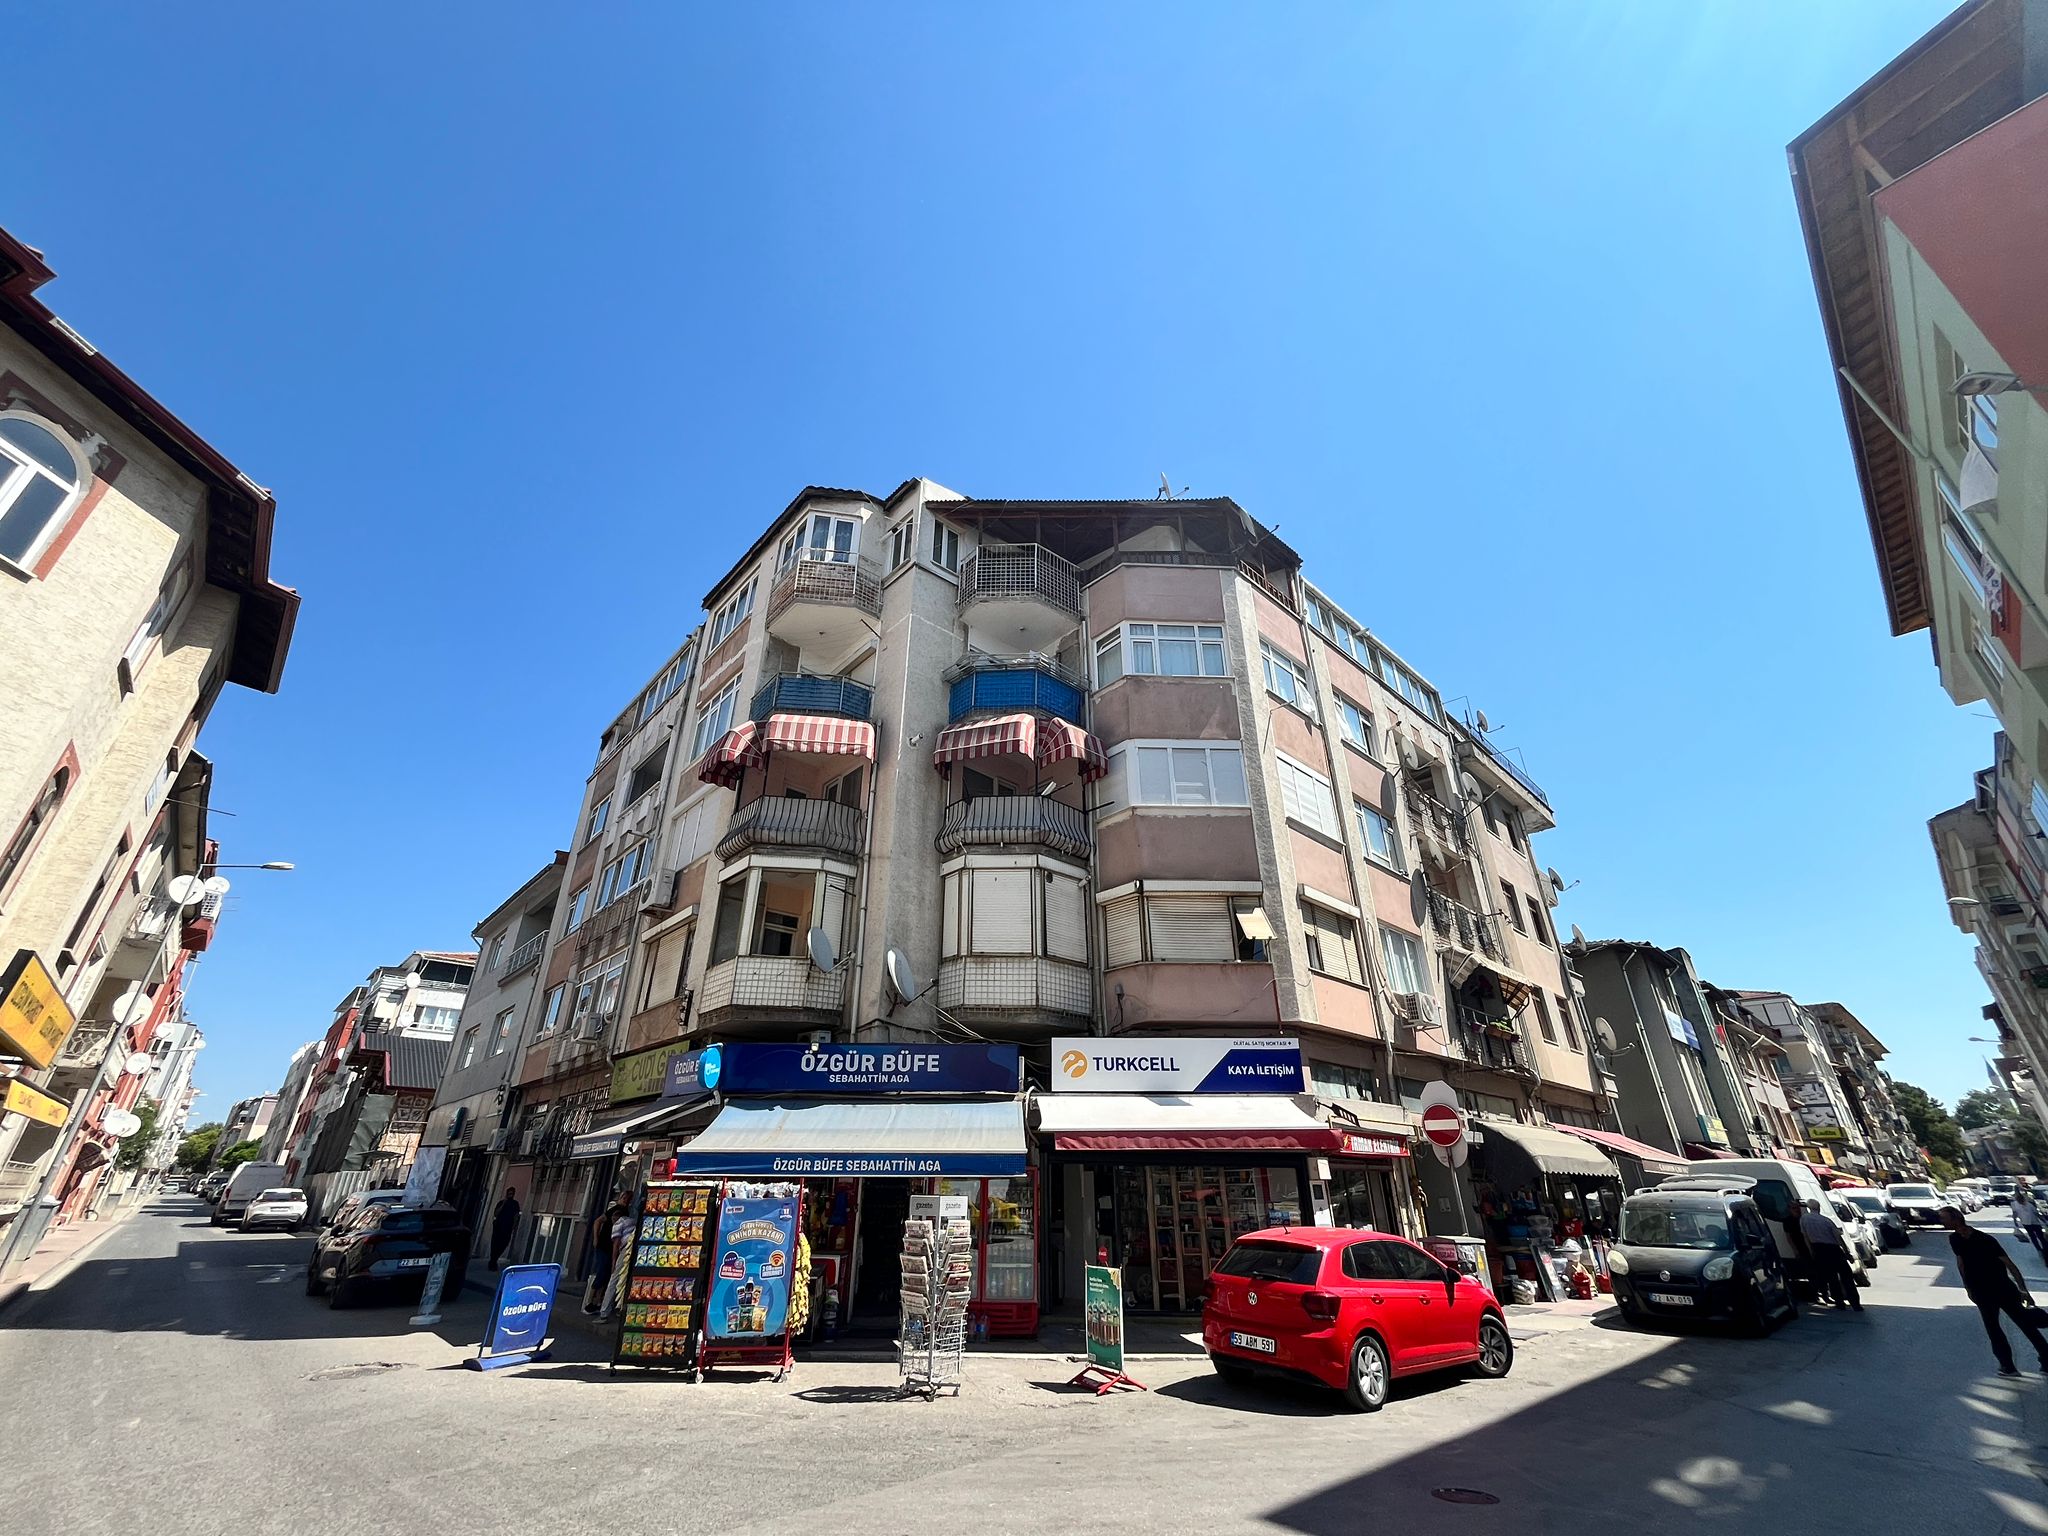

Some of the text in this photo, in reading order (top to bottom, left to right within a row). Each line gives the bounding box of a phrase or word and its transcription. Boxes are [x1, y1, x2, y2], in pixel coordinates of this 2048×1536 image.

[674, 1058, 695, 1075] ÖZGÜR
[801, 1050, 940, 1072] ÖZGÜR BÜFE
[1093, 1057, 1180, 1072] TURKCELL
[1228, 1063, 1295, 1077] KAYA İLETİŞİM
[829, 1073, 888, 1083] SEBAHATTİN
[773, 1158, 811, 1171] ÖZGÜR
[813, 1158, 844, 1171] BÜFE
[845, 1158, 916, 1171] SEBAHATTİN
[503, 1302, 547, 1317] ÖZGÜR BÜFE
[1234, 1333, 1273, 1352] 59 ABM 591
